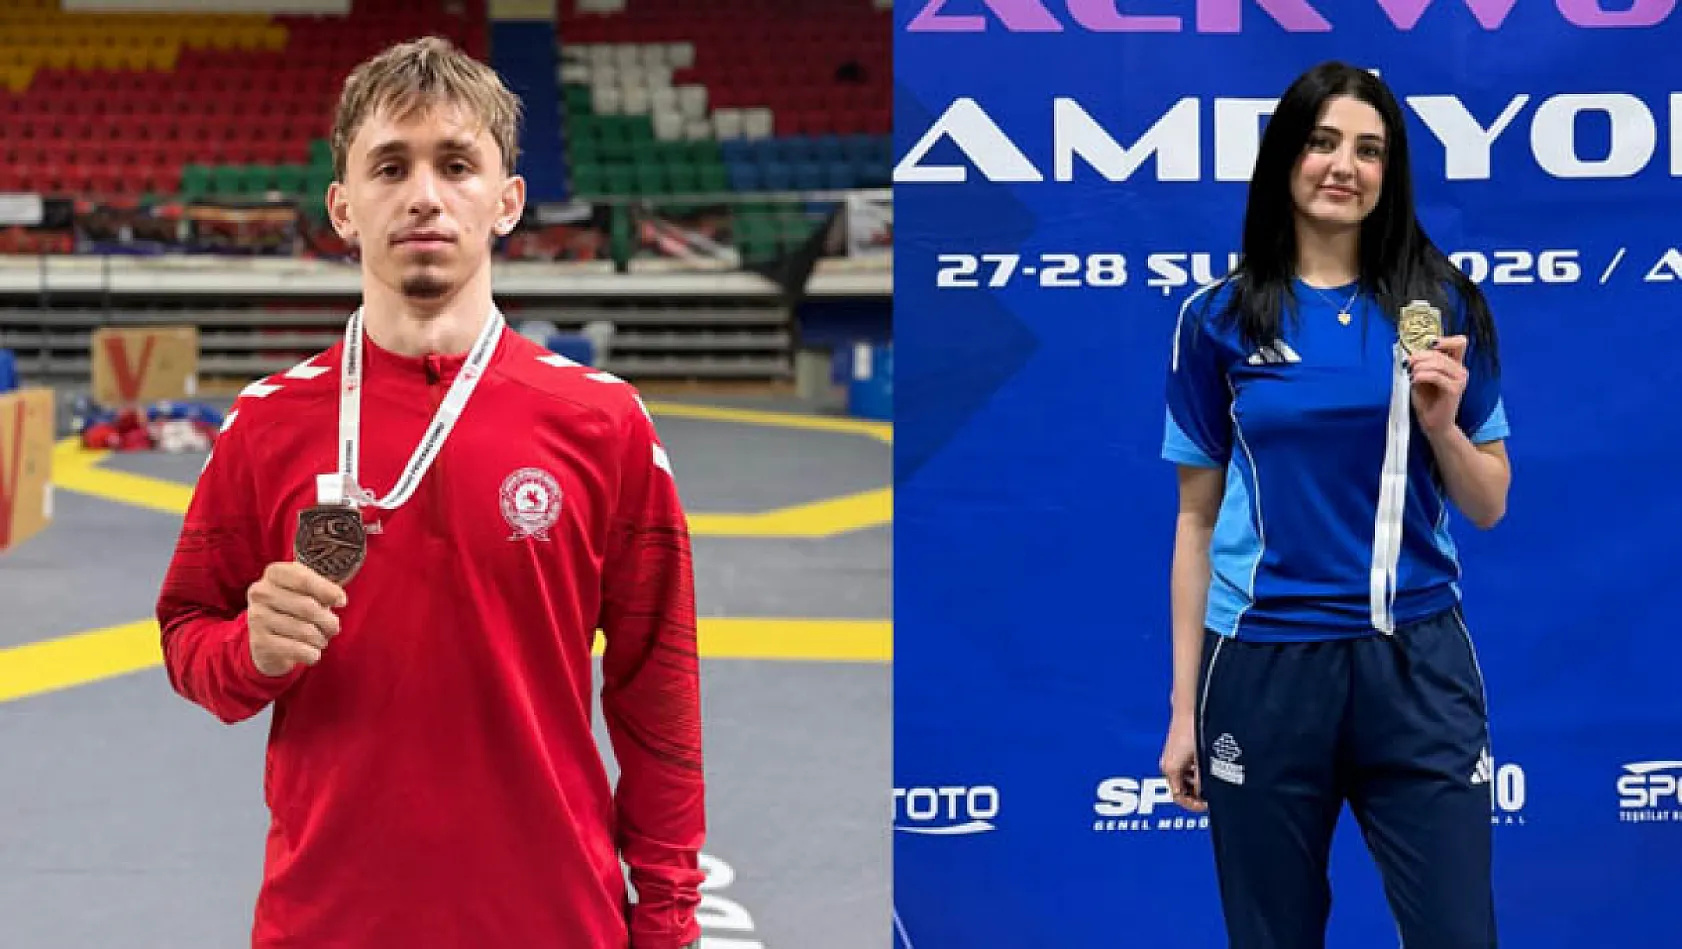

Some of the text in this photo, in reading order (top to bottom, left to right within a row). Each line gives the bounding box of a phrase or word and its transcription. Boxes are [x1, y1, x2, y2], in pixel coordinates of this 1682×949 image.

[936, 253, 1128, 288] 27-28
[1146, 253, 1239, 297] ŞU
[1447, 250, 1581, 285] 026
[1093, 777, 1174, 816] SP
[1616, 774, 1682, 808] SP
[1157, 815, 1210, 830] MÜDÜ
